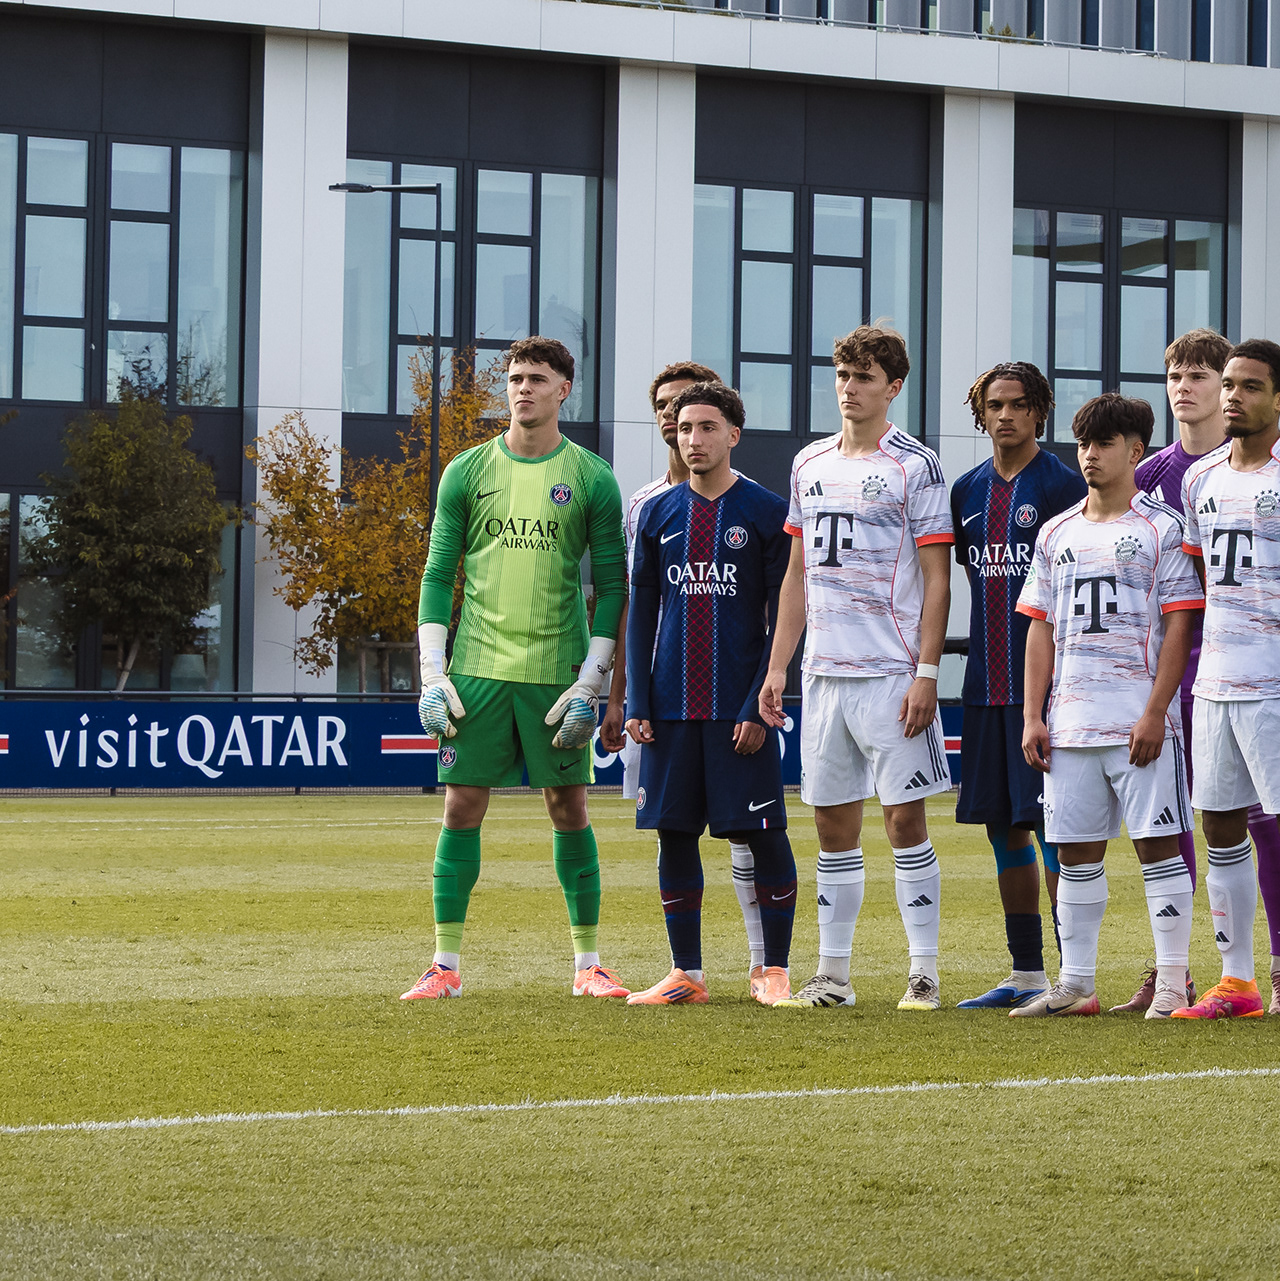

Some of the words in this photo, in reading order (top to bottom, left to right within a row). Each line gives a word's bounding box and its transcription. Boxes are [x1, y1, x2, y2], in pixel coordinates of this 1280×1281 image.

[485, 517, 559, 540] QATAR
[500, 537, 558, 552] AIRWAYS
[969, 543, 1031, 569] QATAR
[667, 562, 737, 585] QATAR
[979, 564, 1031, 578] AIRWAYS
[679, 582, 737, 596] AIRWAYS
